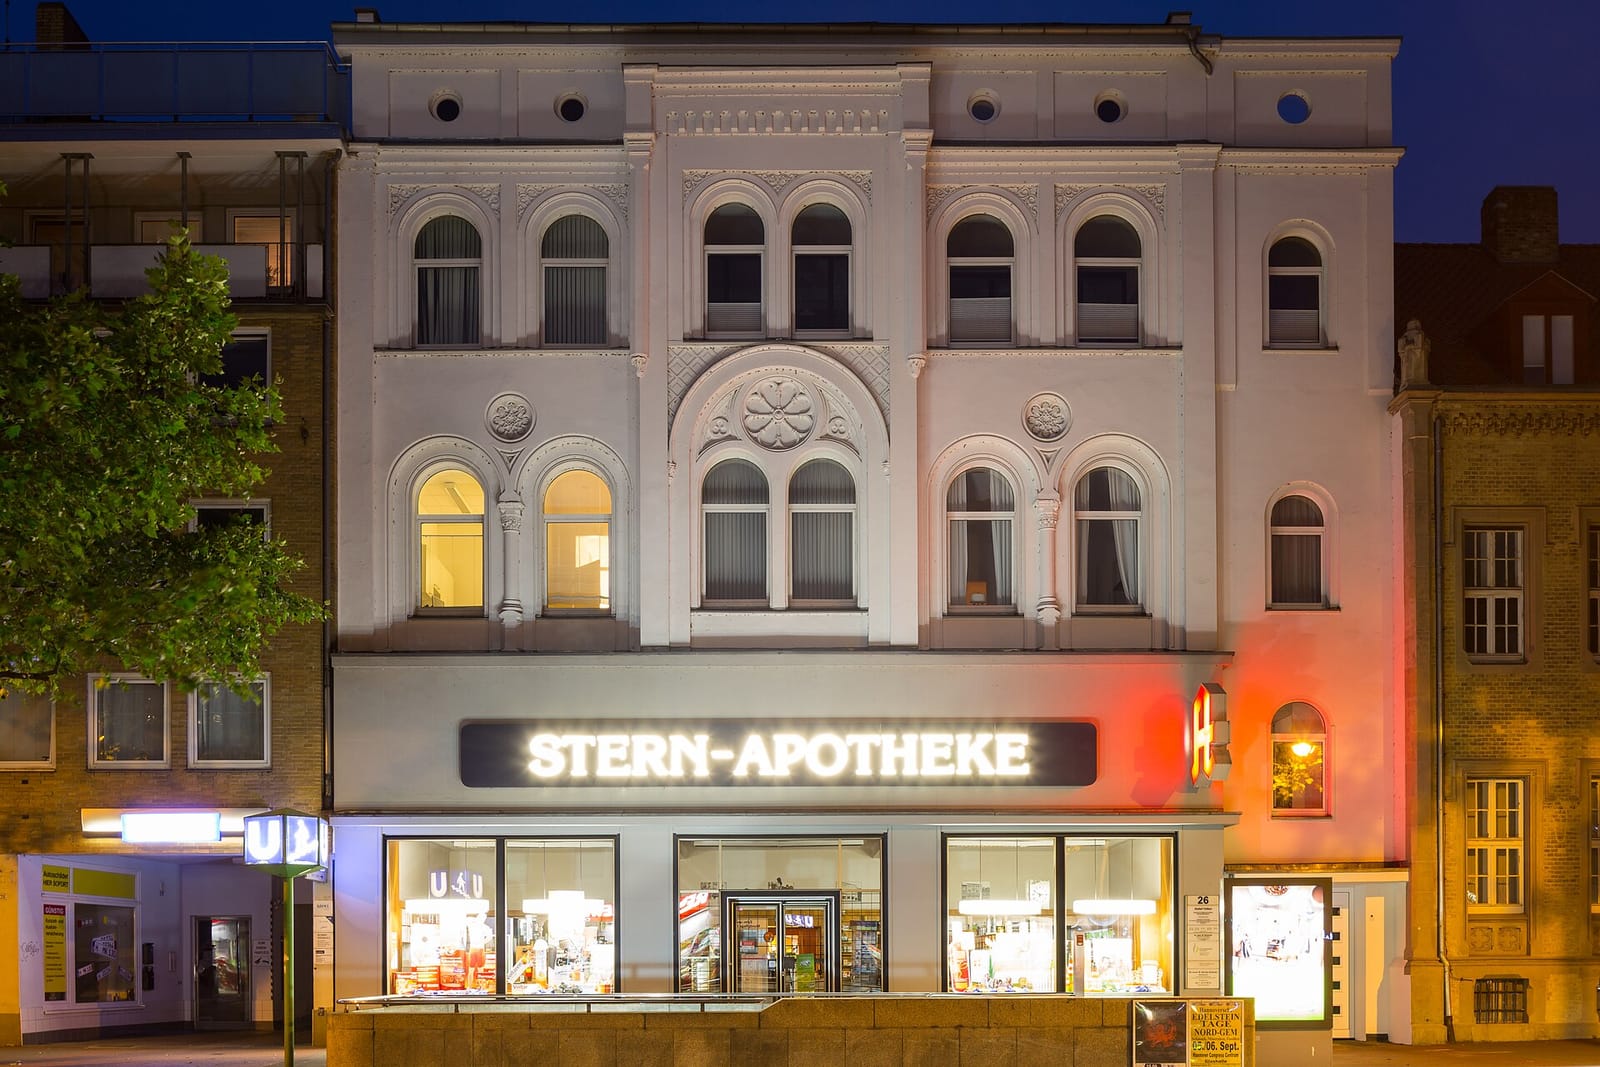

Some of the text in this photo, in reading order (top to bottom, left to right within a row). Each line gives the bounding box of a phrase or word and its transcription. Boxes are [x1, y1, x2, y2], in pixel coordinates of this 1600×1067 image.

[528, 733, 1030, 777] STERN-APOTHEKE
[247, 820, 281, 861] U
[1197, 895, 1209, 905] 26
[1192, 1013, 1240, 1021] EDELSTEIN
[1200, 1020, 1232, 1028] TAGE
[1194, 1028, 1238, 1036] NORD-GEM
[1219, 1041, 1240, 1052] Sept.
